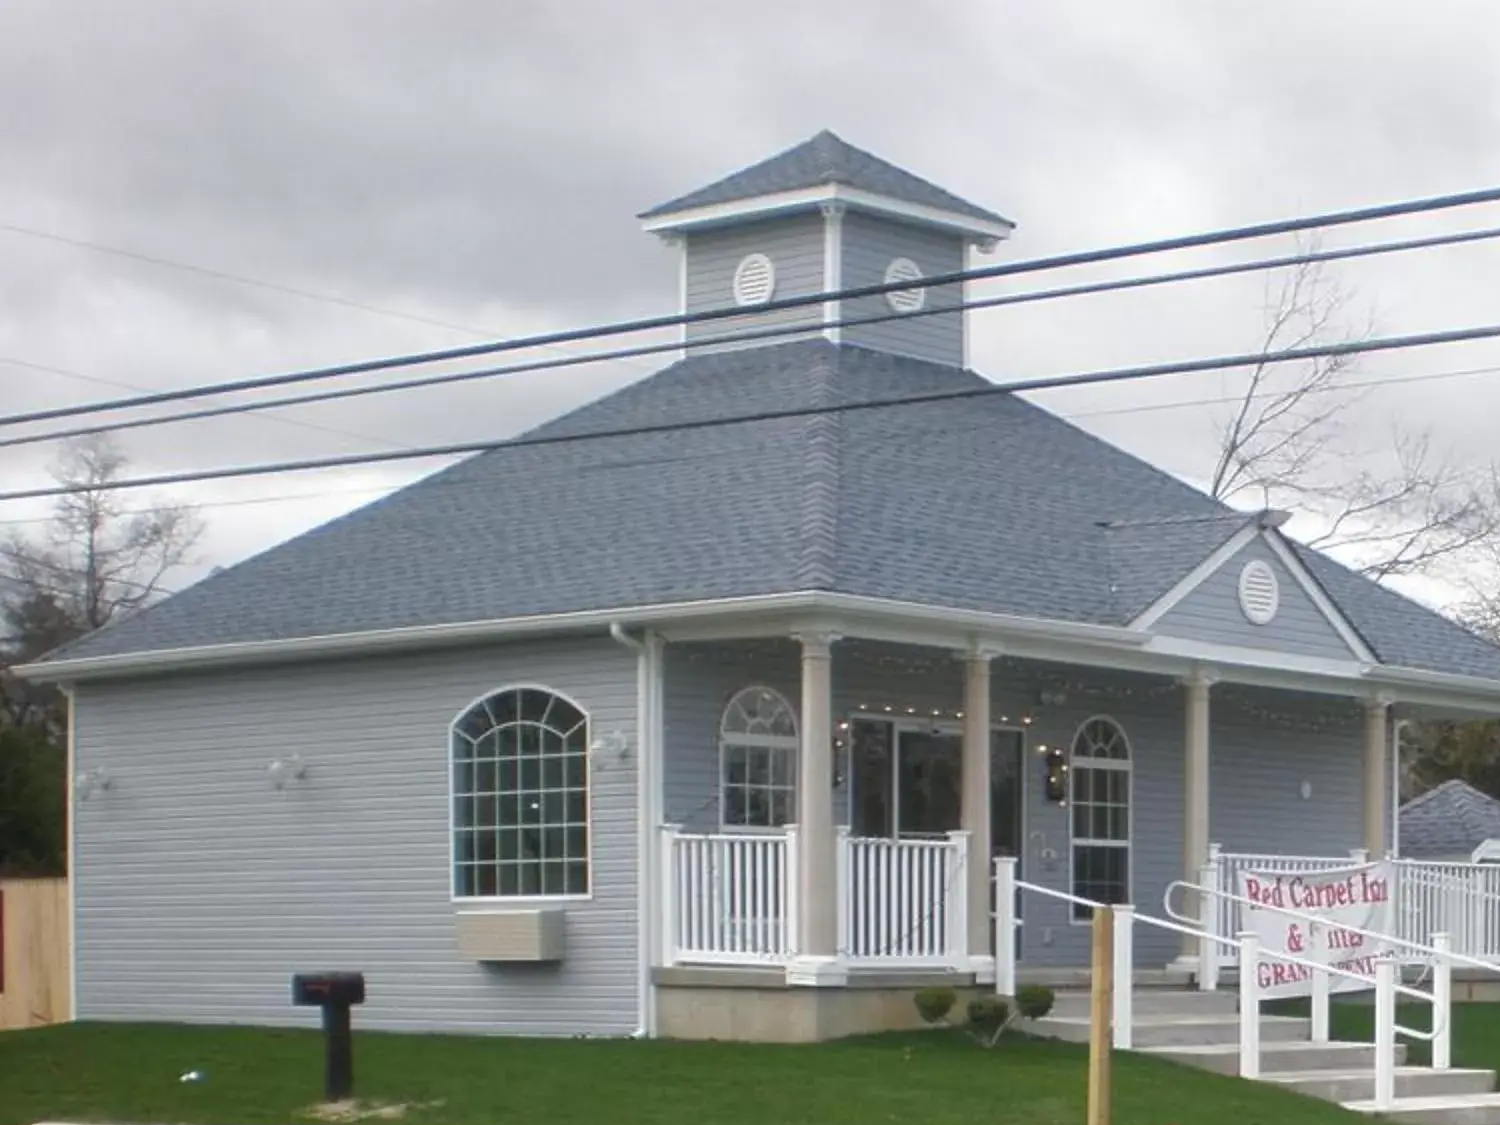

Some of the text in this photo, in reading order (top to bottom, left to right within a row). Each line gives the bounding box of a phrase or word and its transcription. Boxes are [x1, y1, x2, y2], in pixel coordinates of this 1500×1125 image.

[1246, 876, 1284, 908] Red
[1289, 875, 1356, 909] Carpet
[1286, 922, 1304, 953] &
[1257, 959, 1315, 989] GRAN
